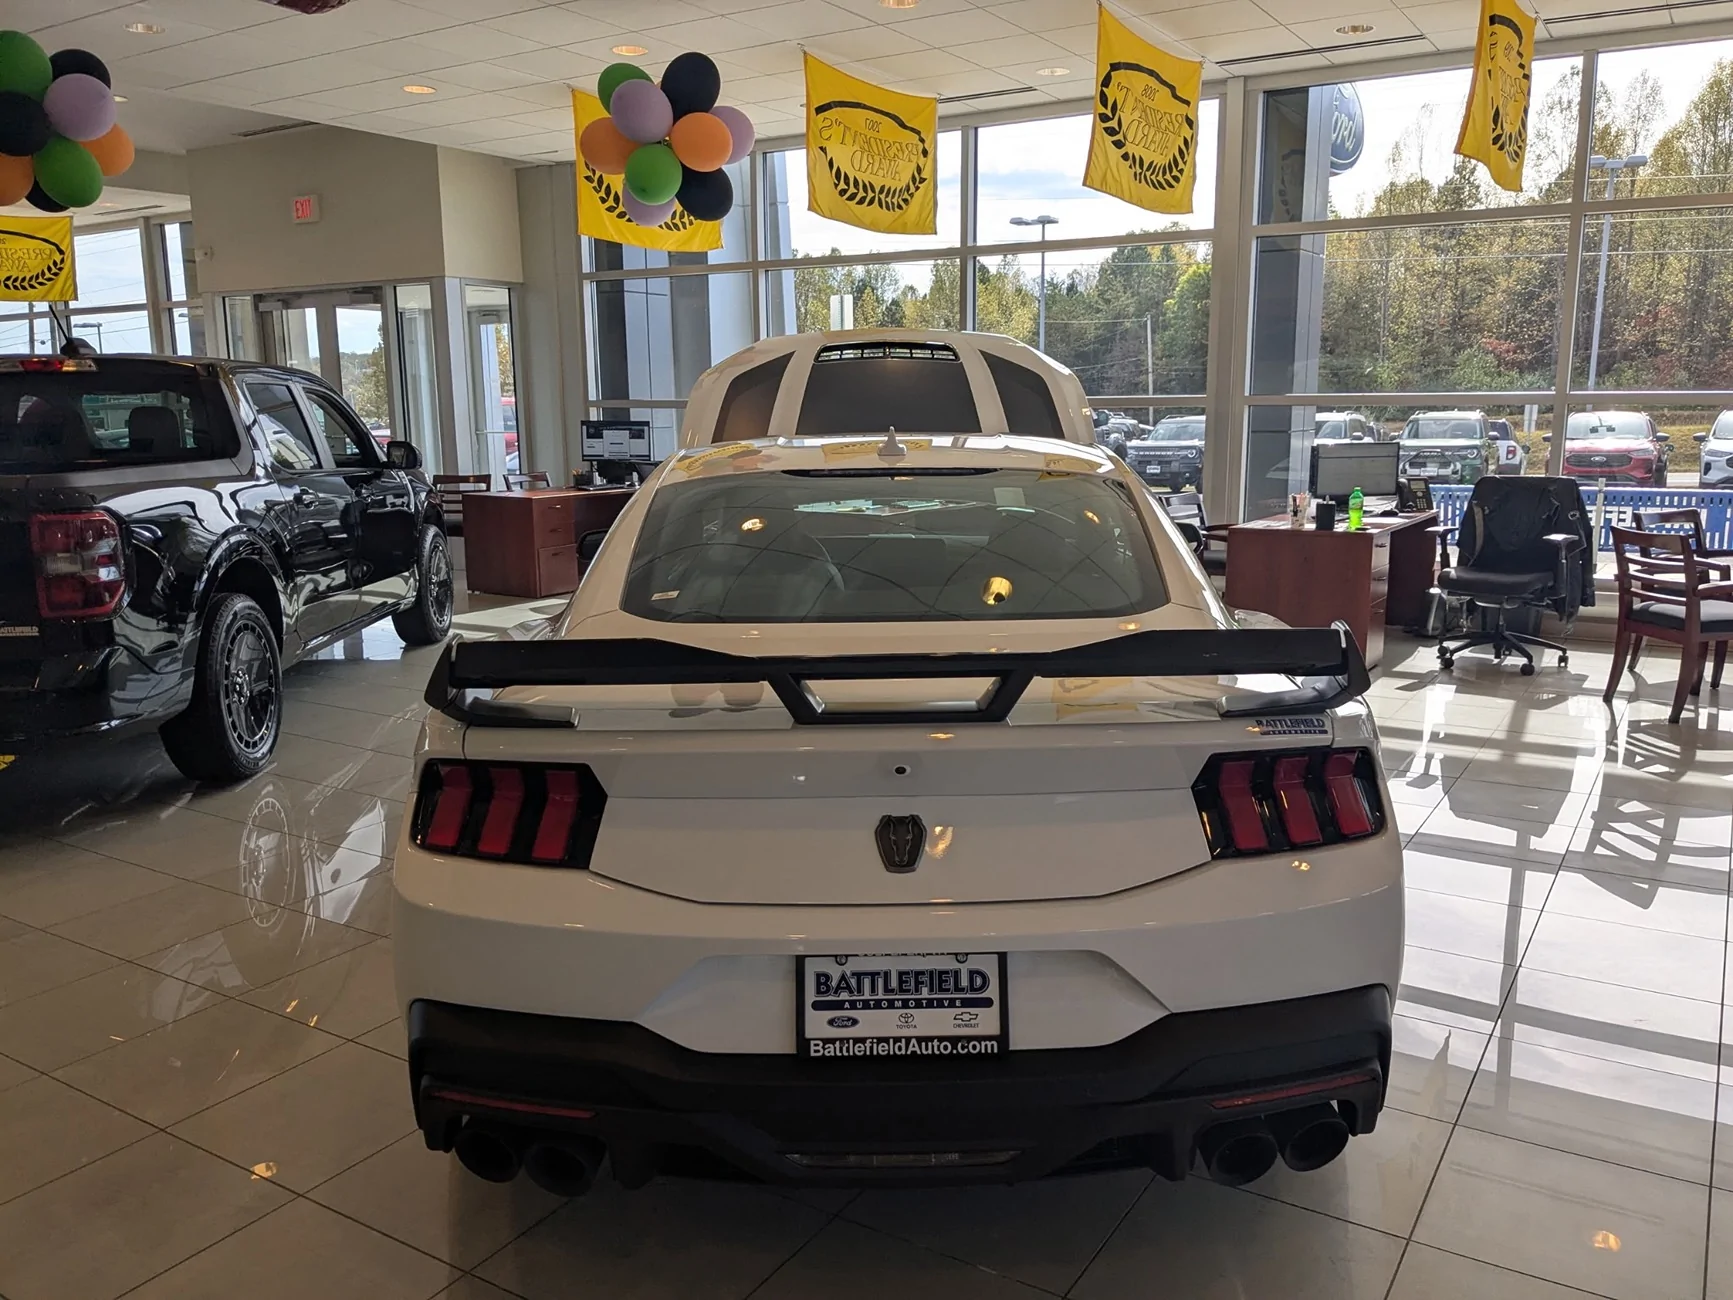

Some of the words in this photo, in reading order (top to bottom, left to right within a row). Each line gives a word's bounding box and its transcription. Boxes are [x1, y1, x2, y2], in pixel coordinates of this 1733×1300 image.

[294, 199, 312, 219] EXIT
[0, 625, 39, 633] ATTLEFIELD
[1255, 718, 1326, 729] BATTLEFIELD
[814, 968, 990, 997] BATTLEFIELD
[844, 999, 962, 1009] AUTOMOTIVE
[810, 1039, 998, 1057] BattlefieldAuto.com
